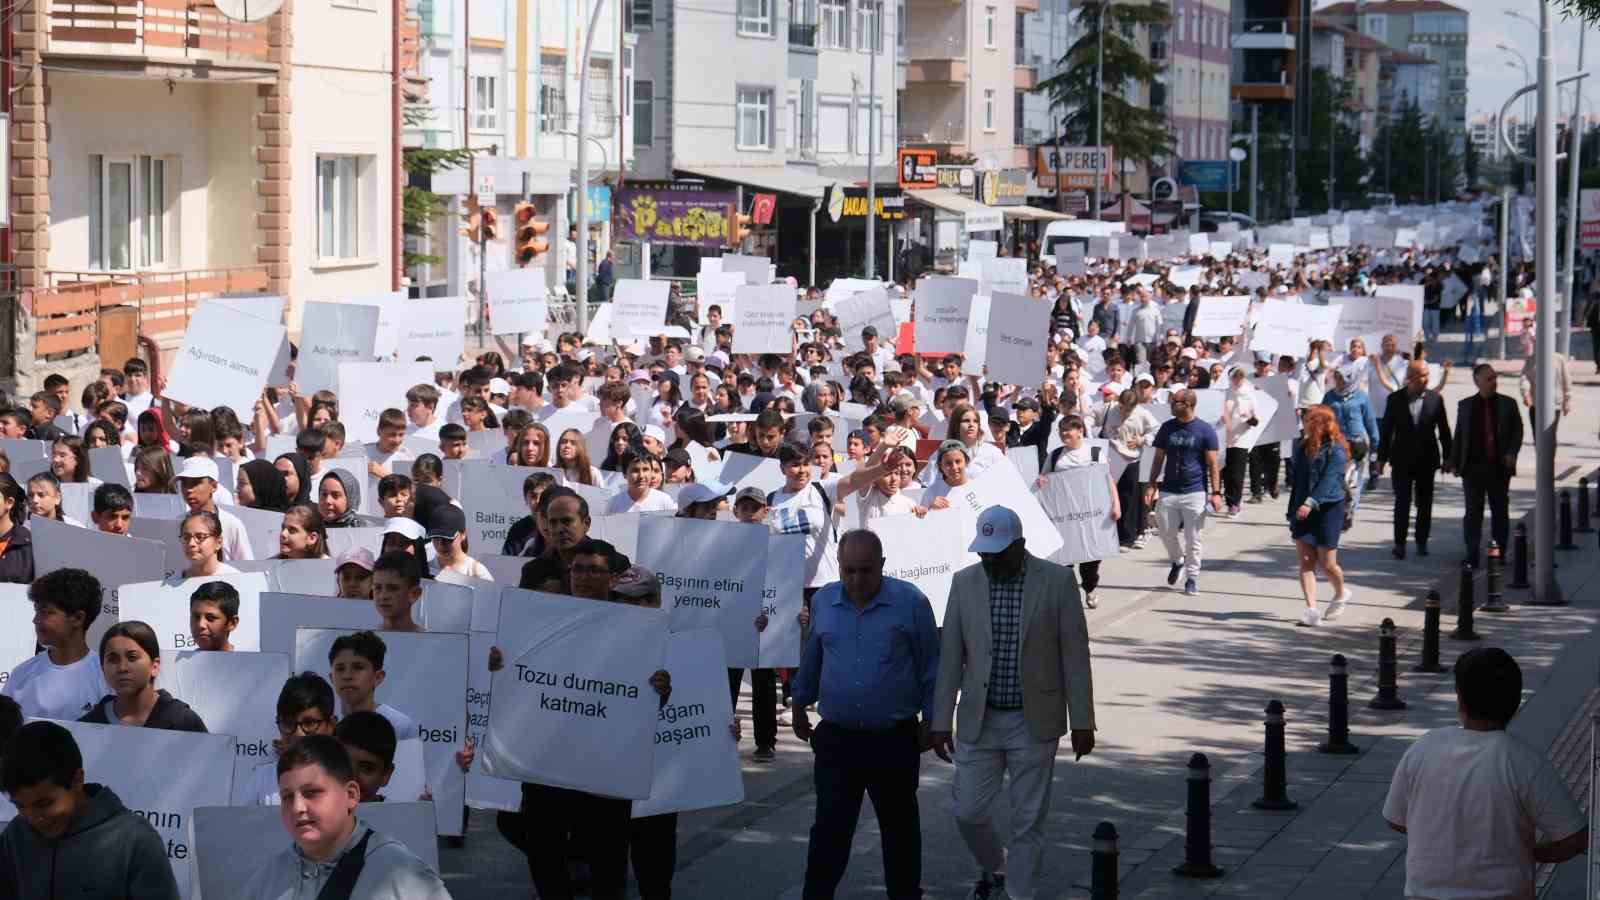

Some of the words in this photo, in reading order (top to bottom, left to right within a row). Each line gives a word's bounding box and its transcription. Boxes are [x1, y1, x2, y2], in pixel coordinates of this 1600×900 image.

[187, 345, 229, 367] Ağırdan
[228, 357, 259, 377] almak
[476, 511, 505, 524] Balta
[656, 572, 710, 590] Başının
[713, 579, 744, 593] etini
[900, 563, 951, 581] bağlamak
[673, 594, 721, 609] yemek
[515, 664, 557, 687] Tozu
[563, 672, 638, 699] dumana
[540, 692, 607, 719] katmak
